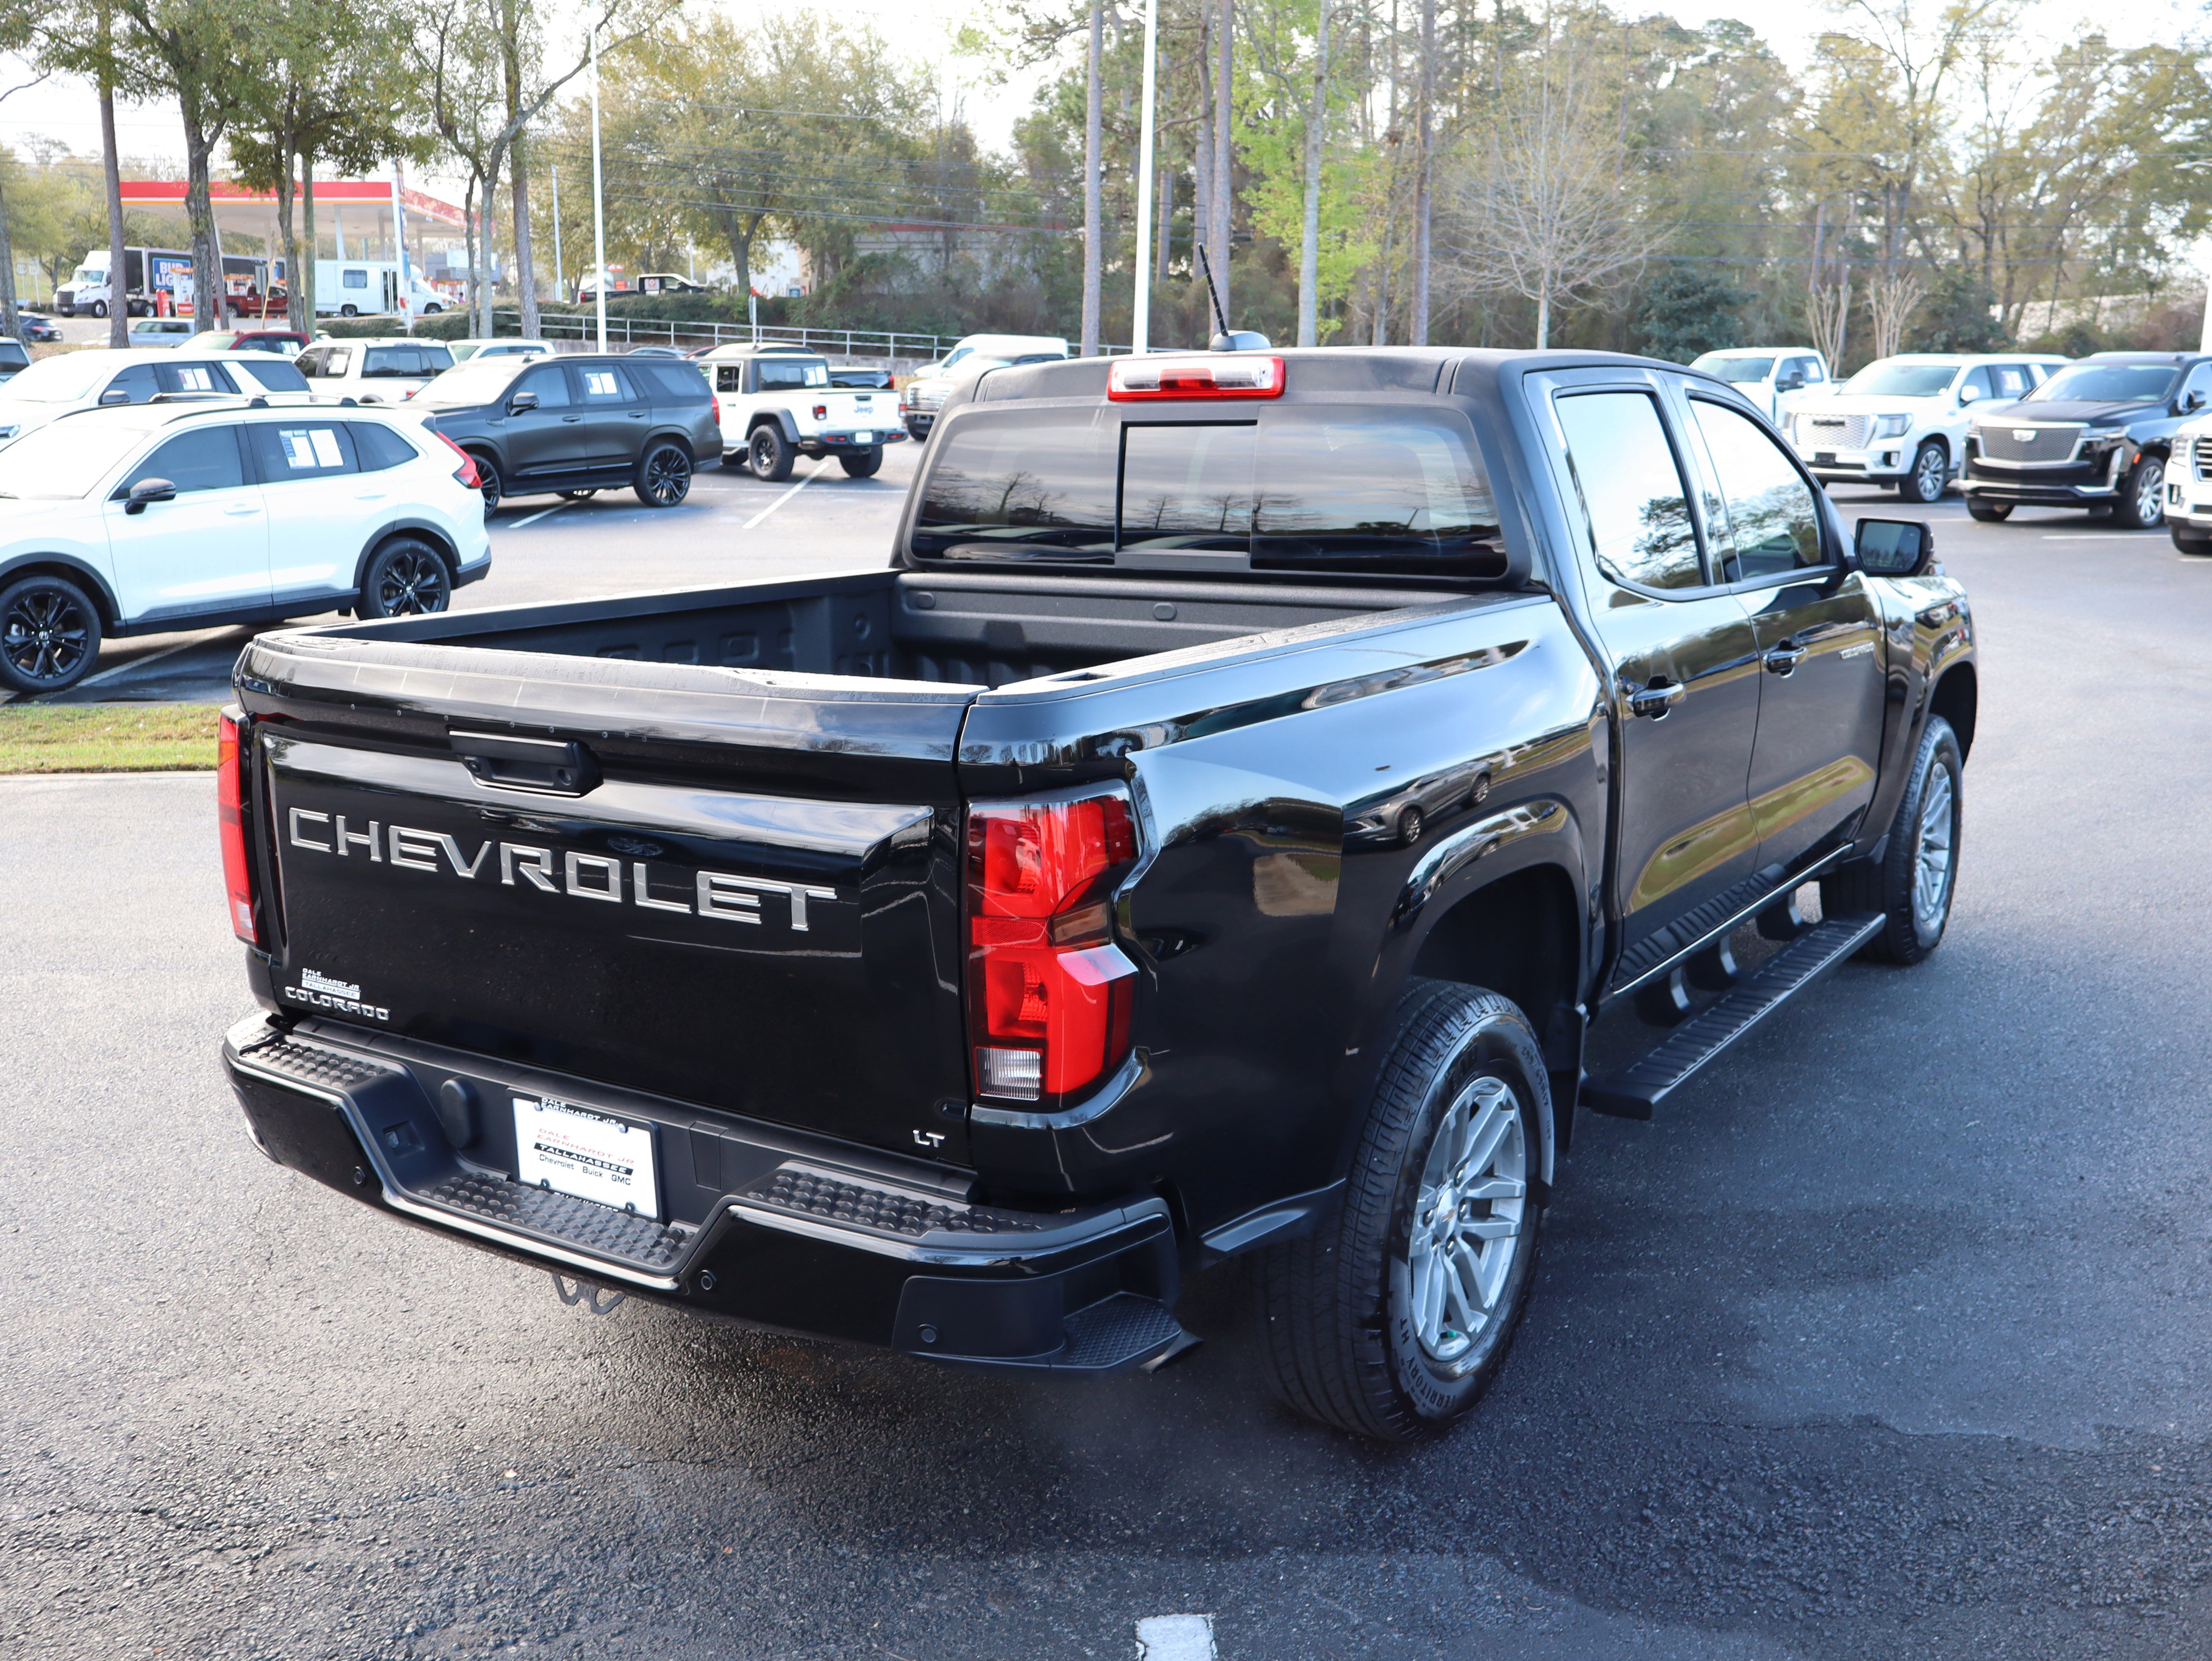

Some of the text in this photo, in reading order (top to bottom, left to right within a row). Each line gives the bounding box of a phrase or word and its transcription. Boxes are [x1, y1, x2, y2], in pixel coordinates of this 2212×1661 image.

[854, 405, 874, 414] Jeep
[288, 806, 838, 931] CHEVROLET
[302, 968, 322, 977] DALE
[302, 973, 347, 987] EARNHARDT
[305, 981, 357, 997] TALLAHASSEE
[285, 986, 390, 1020] COLORADO
[541, 1097, 567, 1108] DALE
[541, 1102, 601, 1121] EARNHARDT
[538, 1128, 570, 1140] DALE
[913, 1129, 945, 1148] LT
[537, 1134, 635, 1165] EARNHARDT JR
[539, 1144, 627, 1173] TALLAHASSEE
[539, 1154, 631, 1186] Chevrolet Buick GMC
[1400, 1317, 1410, 1345] HT
[1407, 1356, 1456, 1409] TERRITORY
